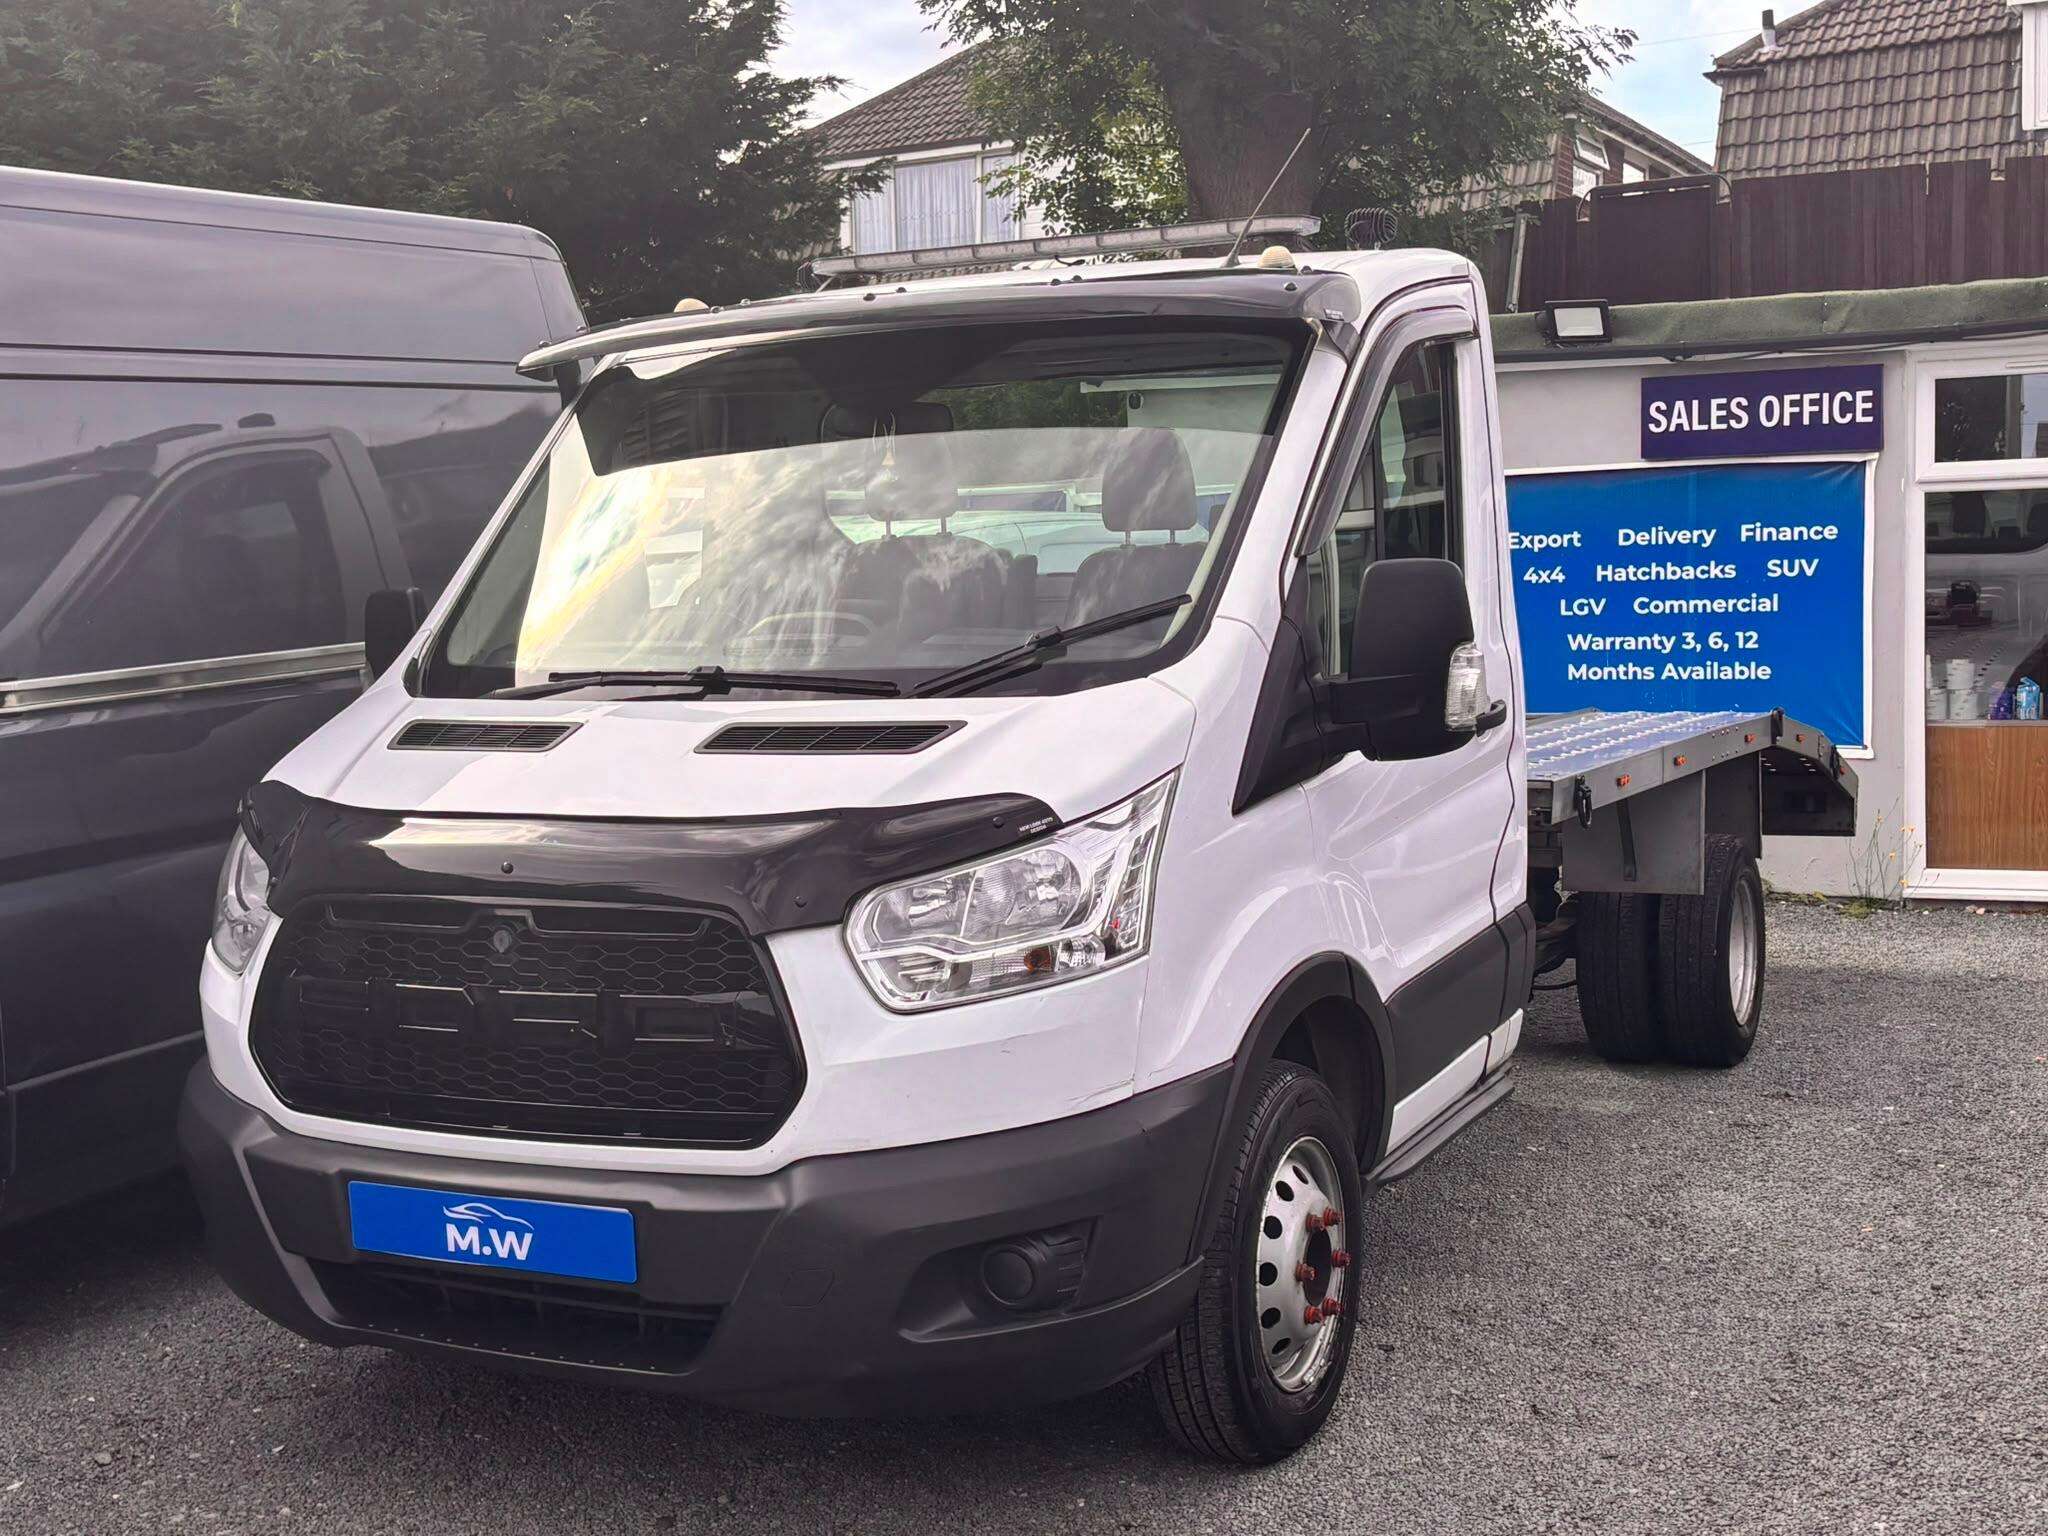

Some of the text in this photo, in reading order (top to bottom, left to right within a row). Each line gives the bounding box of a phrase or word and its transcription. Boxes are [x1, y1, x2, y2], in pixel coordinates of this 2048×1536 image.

[1647, 389, 1875, 434] SALES OFFICE
[1509, 522, 1839, 553] Export Delivery Finance
[1523, 558, 1820, 584] 4x4 Hatchbacks SUV
[1560, 593, 1779, 616] LGV Commercial
[1567, 631, 1759, 654] Warranty 3, 6, 12
[1567, 661, 1772, 680] Months Available
[445, 1223, 534, 1261] M.W
